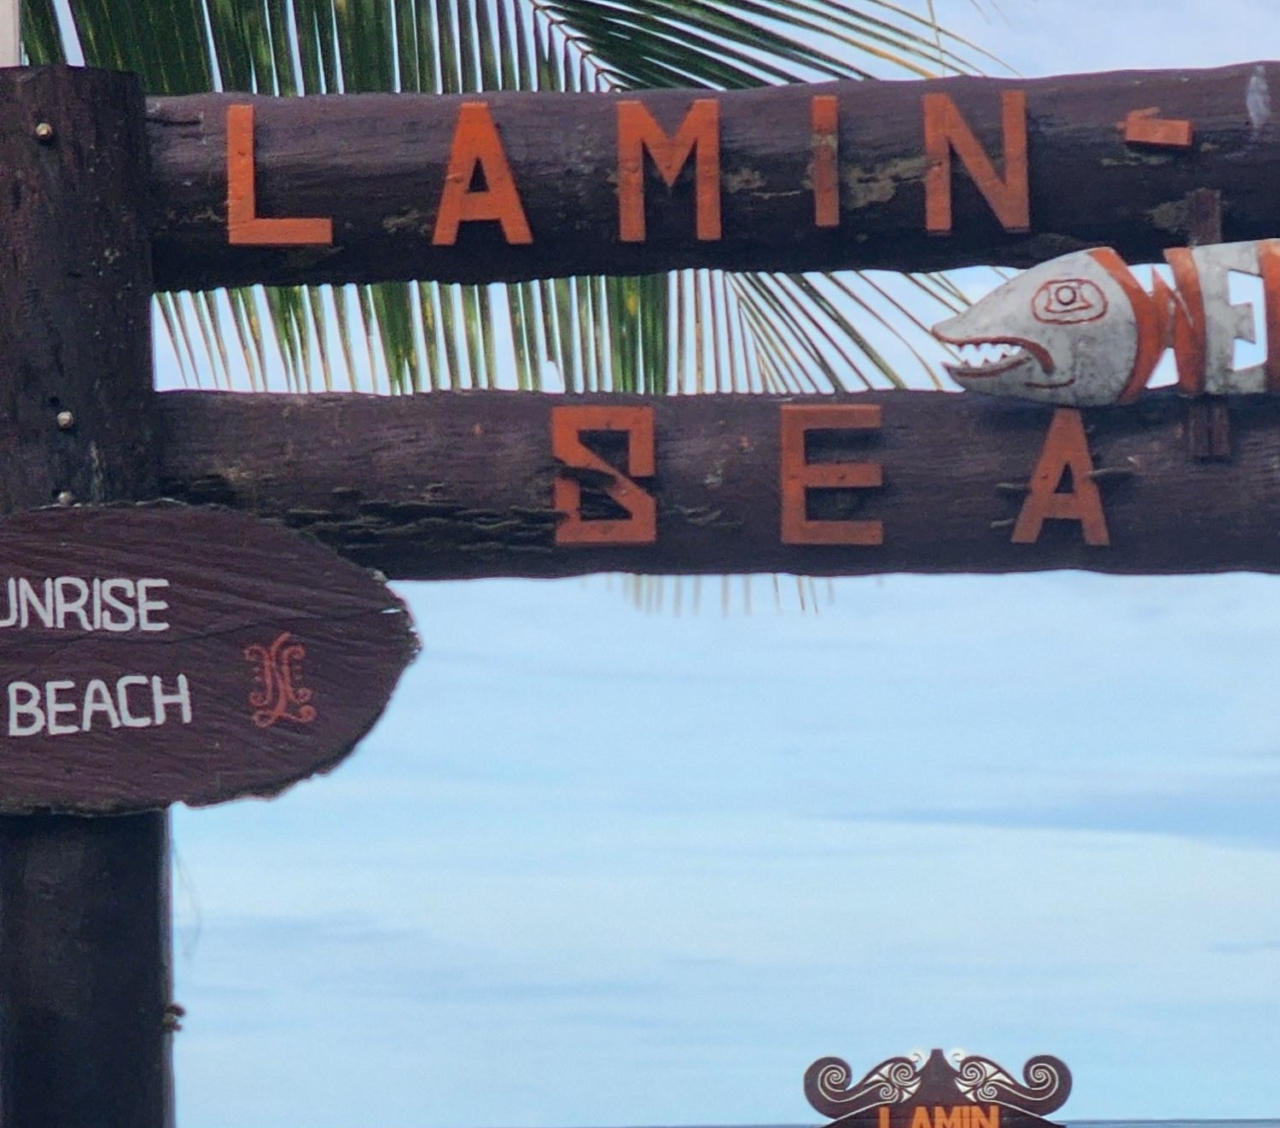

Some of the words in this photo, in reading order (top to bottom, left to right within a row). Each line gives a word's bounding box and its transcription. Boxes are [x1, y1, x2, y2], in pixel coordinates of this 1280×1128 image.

[226, 90, 1031, 246] LAMIN
[551, 404, 1111, 546] SEA
[8, 673, 192, 736] BEACH
